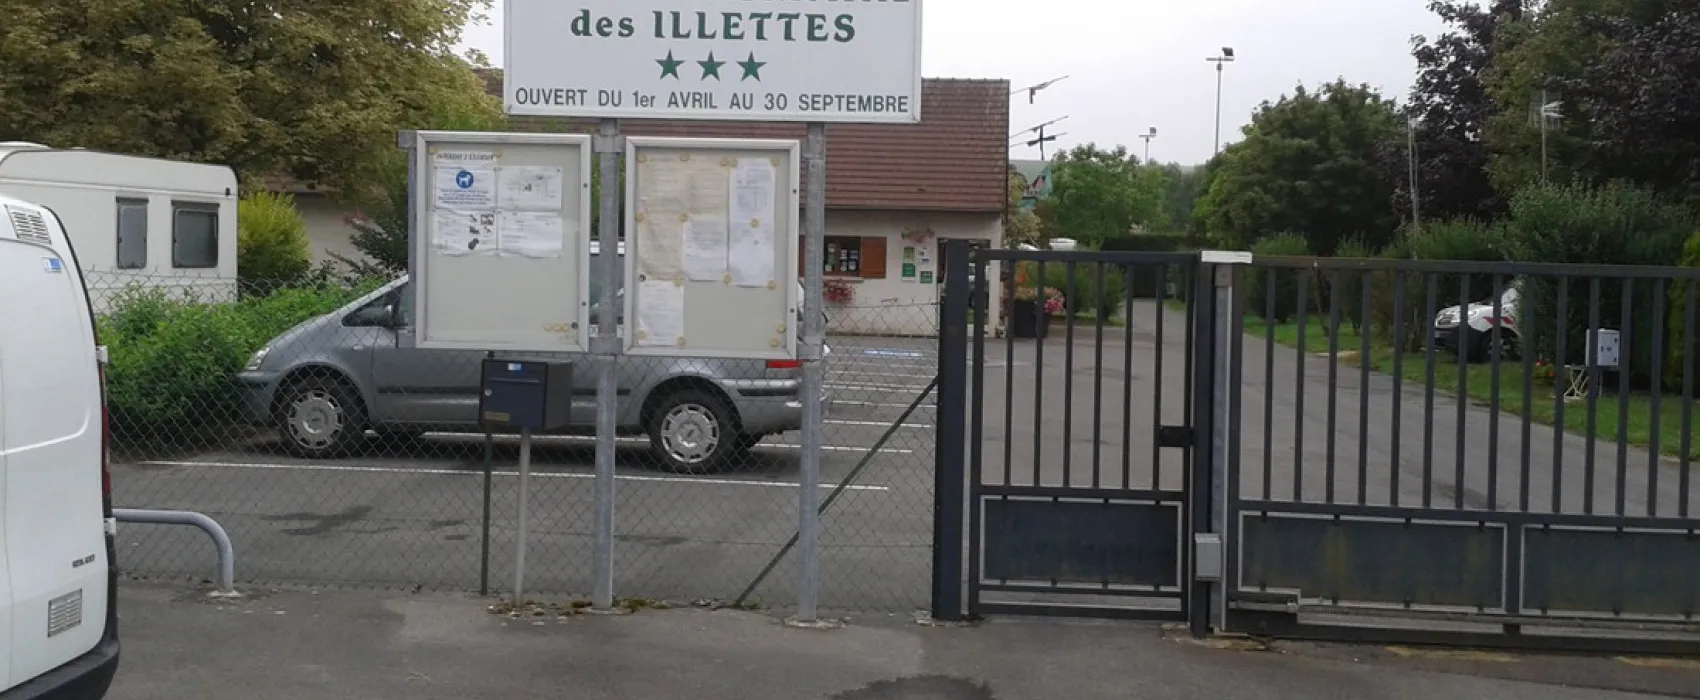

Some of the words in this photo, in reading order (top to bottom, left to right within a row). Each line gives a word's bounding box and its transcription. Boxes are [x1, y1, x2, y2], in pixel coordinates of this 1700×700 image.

[571, 9, 635, 37] des
[653, 10, 856, 42] ILLETTES
[515, 87, 588, 107] OUVERT
[598, 90, 623, 108] DU
[632, 91, 656, 108] 1er
[668, 92, 718, 109] AVRIL
[730, 93, 754, 111] AU
[764, 93, 788, 111] 30
[798, 94, 909, 113] SEPTEMBRE
